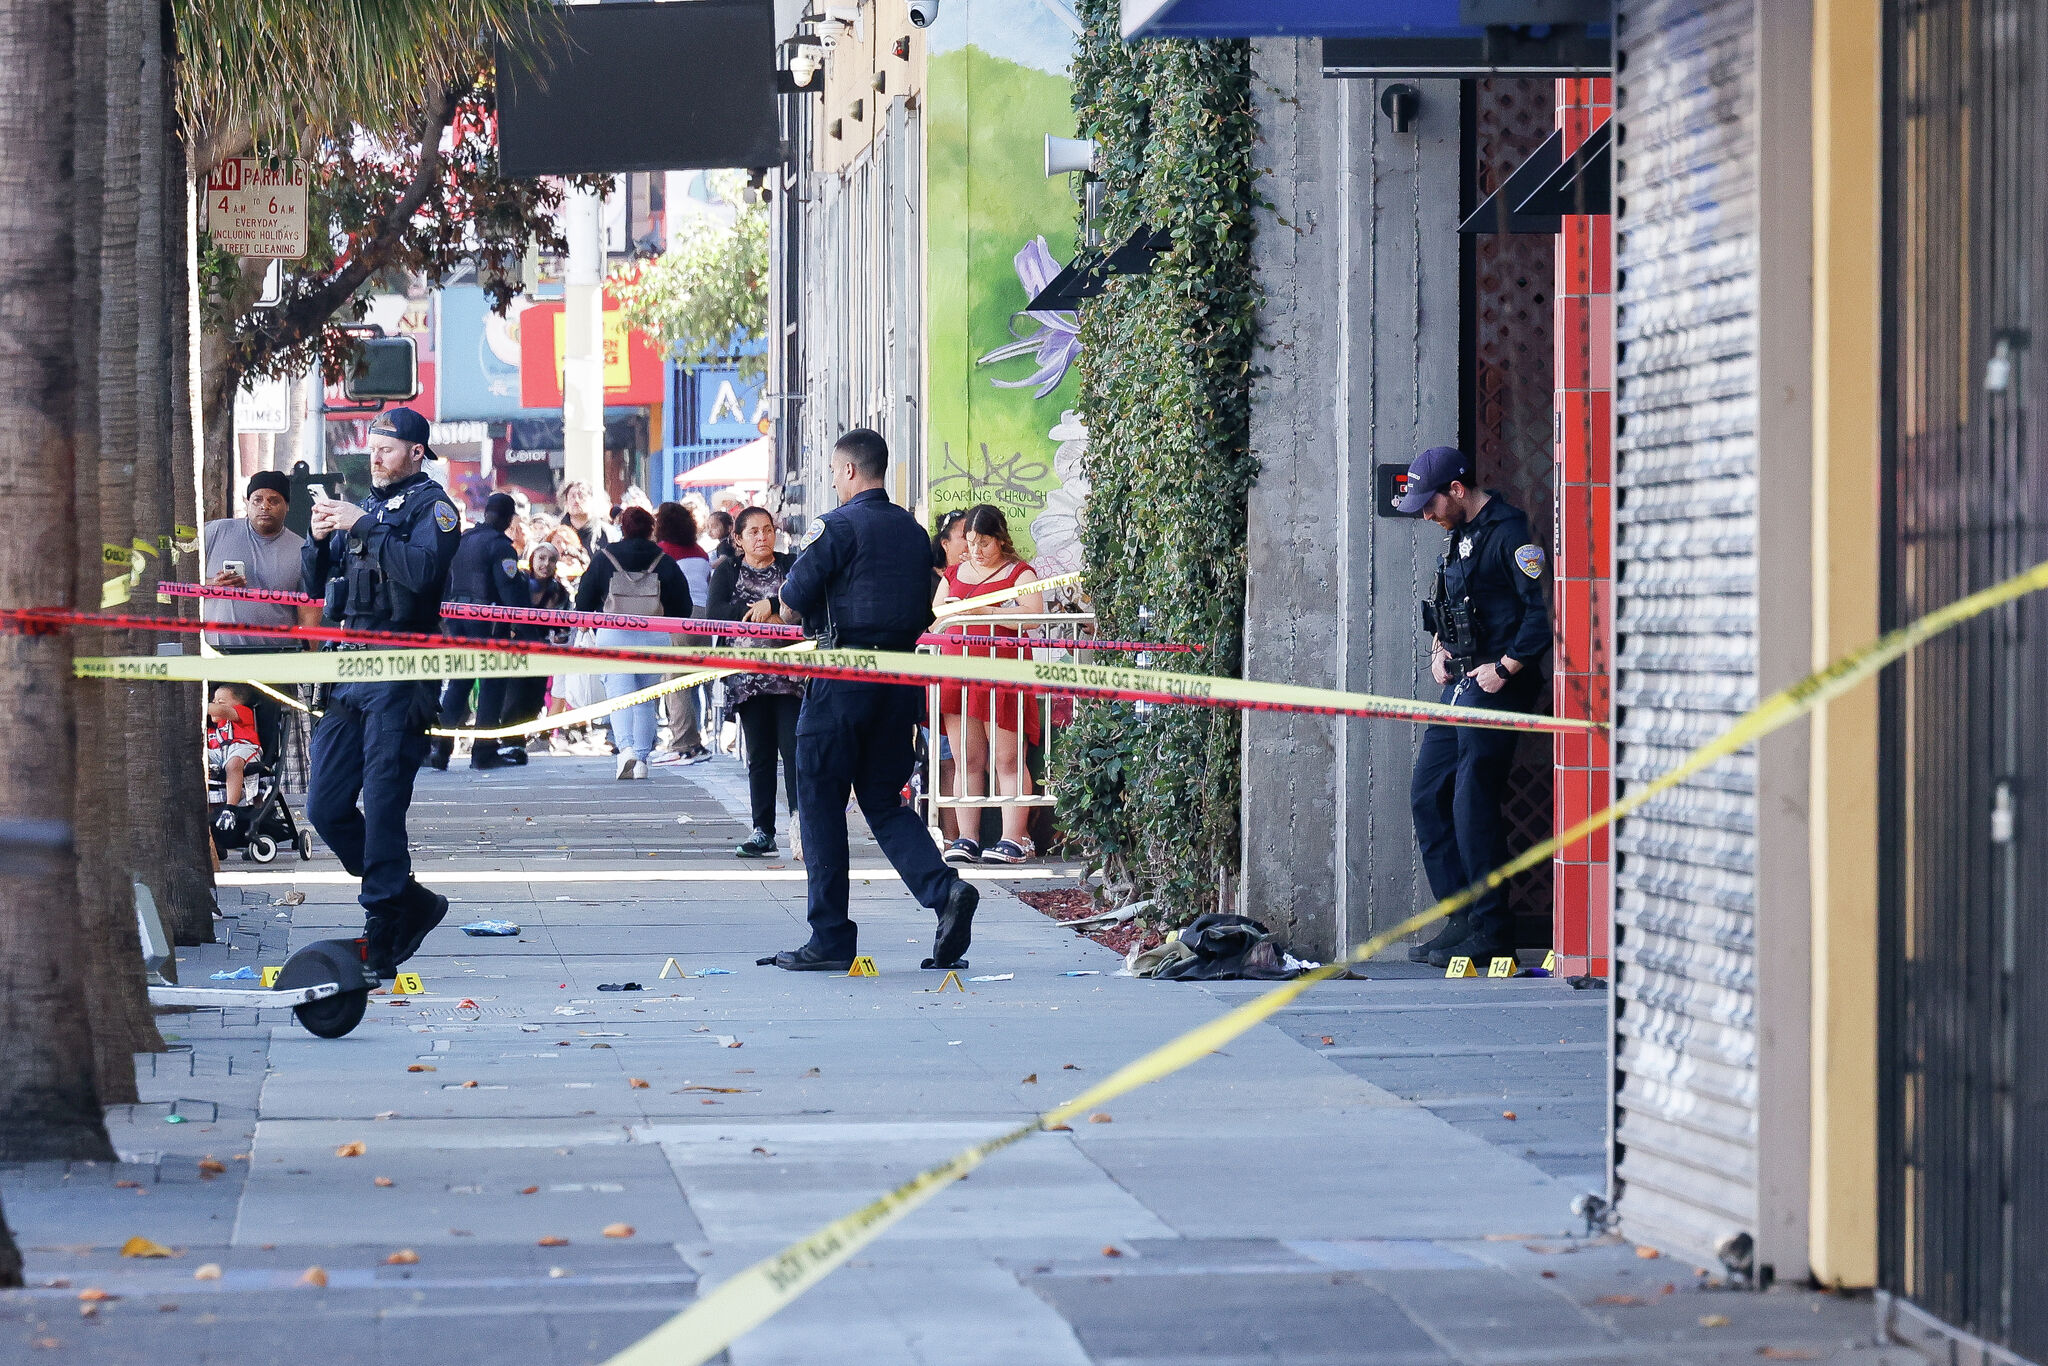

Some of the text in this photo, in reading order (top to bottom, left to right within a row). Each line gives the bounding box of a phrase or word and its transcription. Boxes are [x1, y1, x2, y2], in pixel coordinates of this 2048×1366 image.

[211, 161, 238, 187] NO
[217, 196, 229, 213] 4
[253, 198, 261, 206] TO
[268, 196, 279, 214] 6
[235, 218, 278, 227] EVERYDAY
[214, 230, 299, 241] INCLUDING HOLIDAYS
[219, 243, 296, 254] TREET CLEANING
[468, 605, 524, 620] SCENE
[527, 609, 551, 622] DO
[555, 611, 586, 625] NOT
[592, 614, 650, 629] CROSS
[681, 619, 734, 634] CRIME
[736, 624, 793, 638] SCENE
[950, 635, 1002, 647] CRIME
[862, 958, 876, 973] 11
[1451, 959, 1466, 973] 15
[1493, 960, 1507, 974] 14
[406, 977, 418, 991] 5
